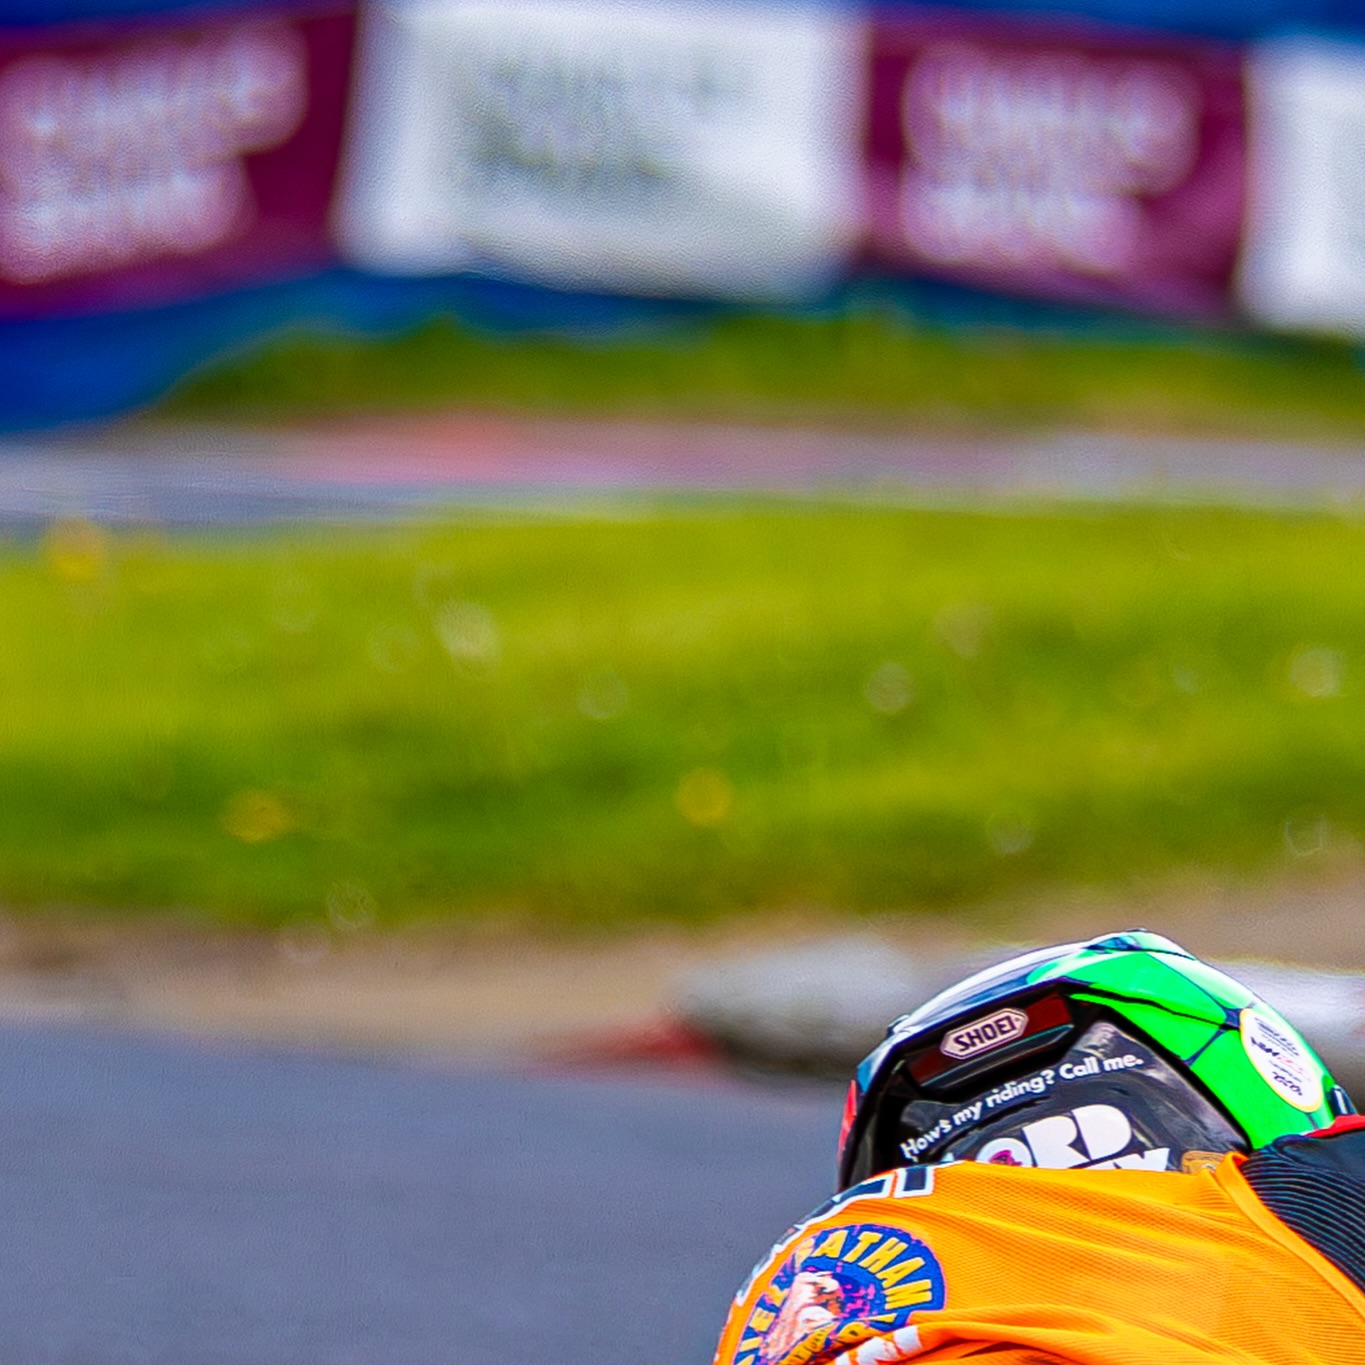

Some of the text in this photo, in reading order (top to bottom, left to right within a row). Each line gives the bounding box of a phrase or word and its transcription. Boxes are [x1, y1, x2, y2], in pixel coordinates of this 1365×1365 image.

[953, 1015, 1016, 1053] SHOEI
[953, 1102, 983, 1128] my
[983, 1067, 1056, 1108] riding?
[1059, 1056, 1101, 1080] Call
[1103, 1053, 1145, 1072] me.
